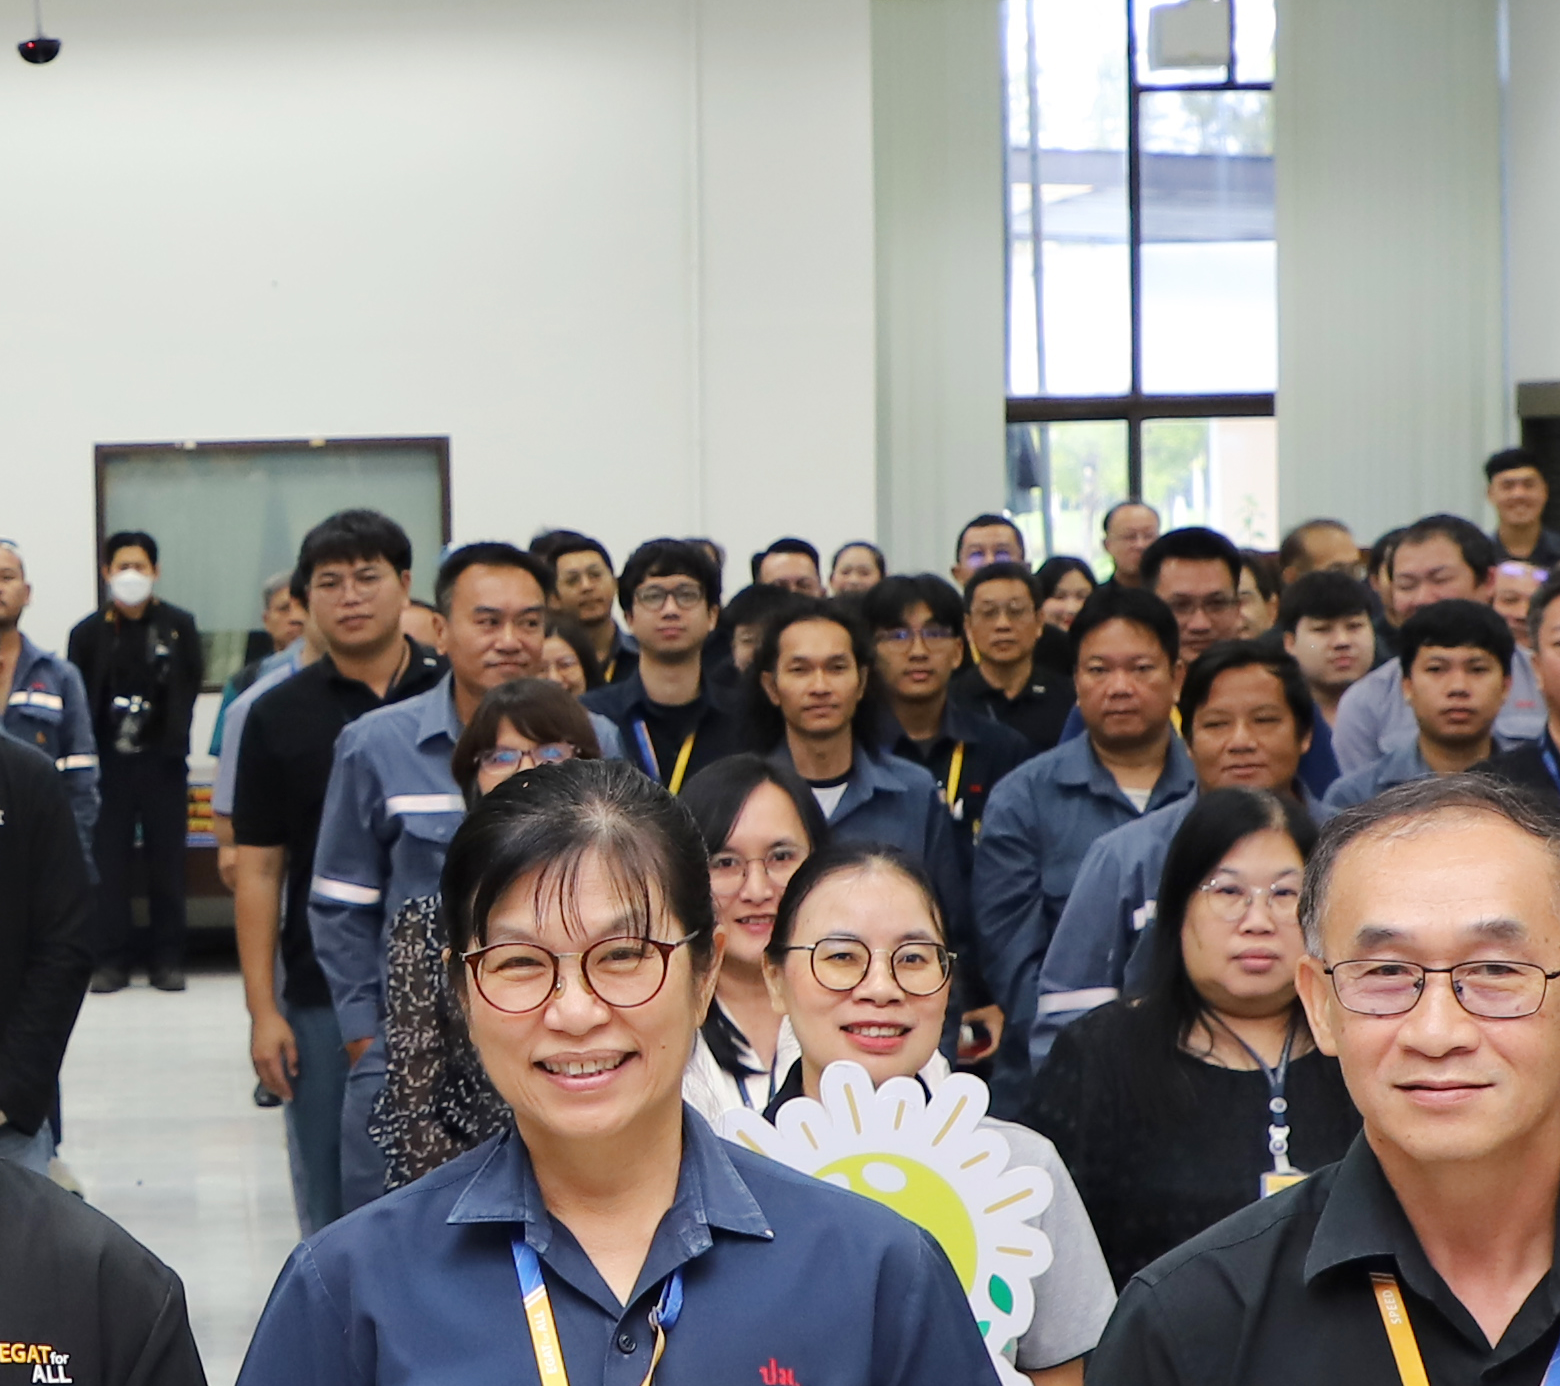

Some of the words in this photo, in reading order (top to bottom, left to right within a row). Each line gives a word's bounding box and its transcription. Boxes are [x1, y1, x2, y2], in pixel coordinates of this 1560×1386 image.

[1382, 1289, 1402, 1325] SPEED
[533, 1310, 548, 1332] ALL
[49, 1351, 70, 1365] for
[541, 1344, 558, 1375] EGAT
[32, 1364, 73, 1384] ALL
